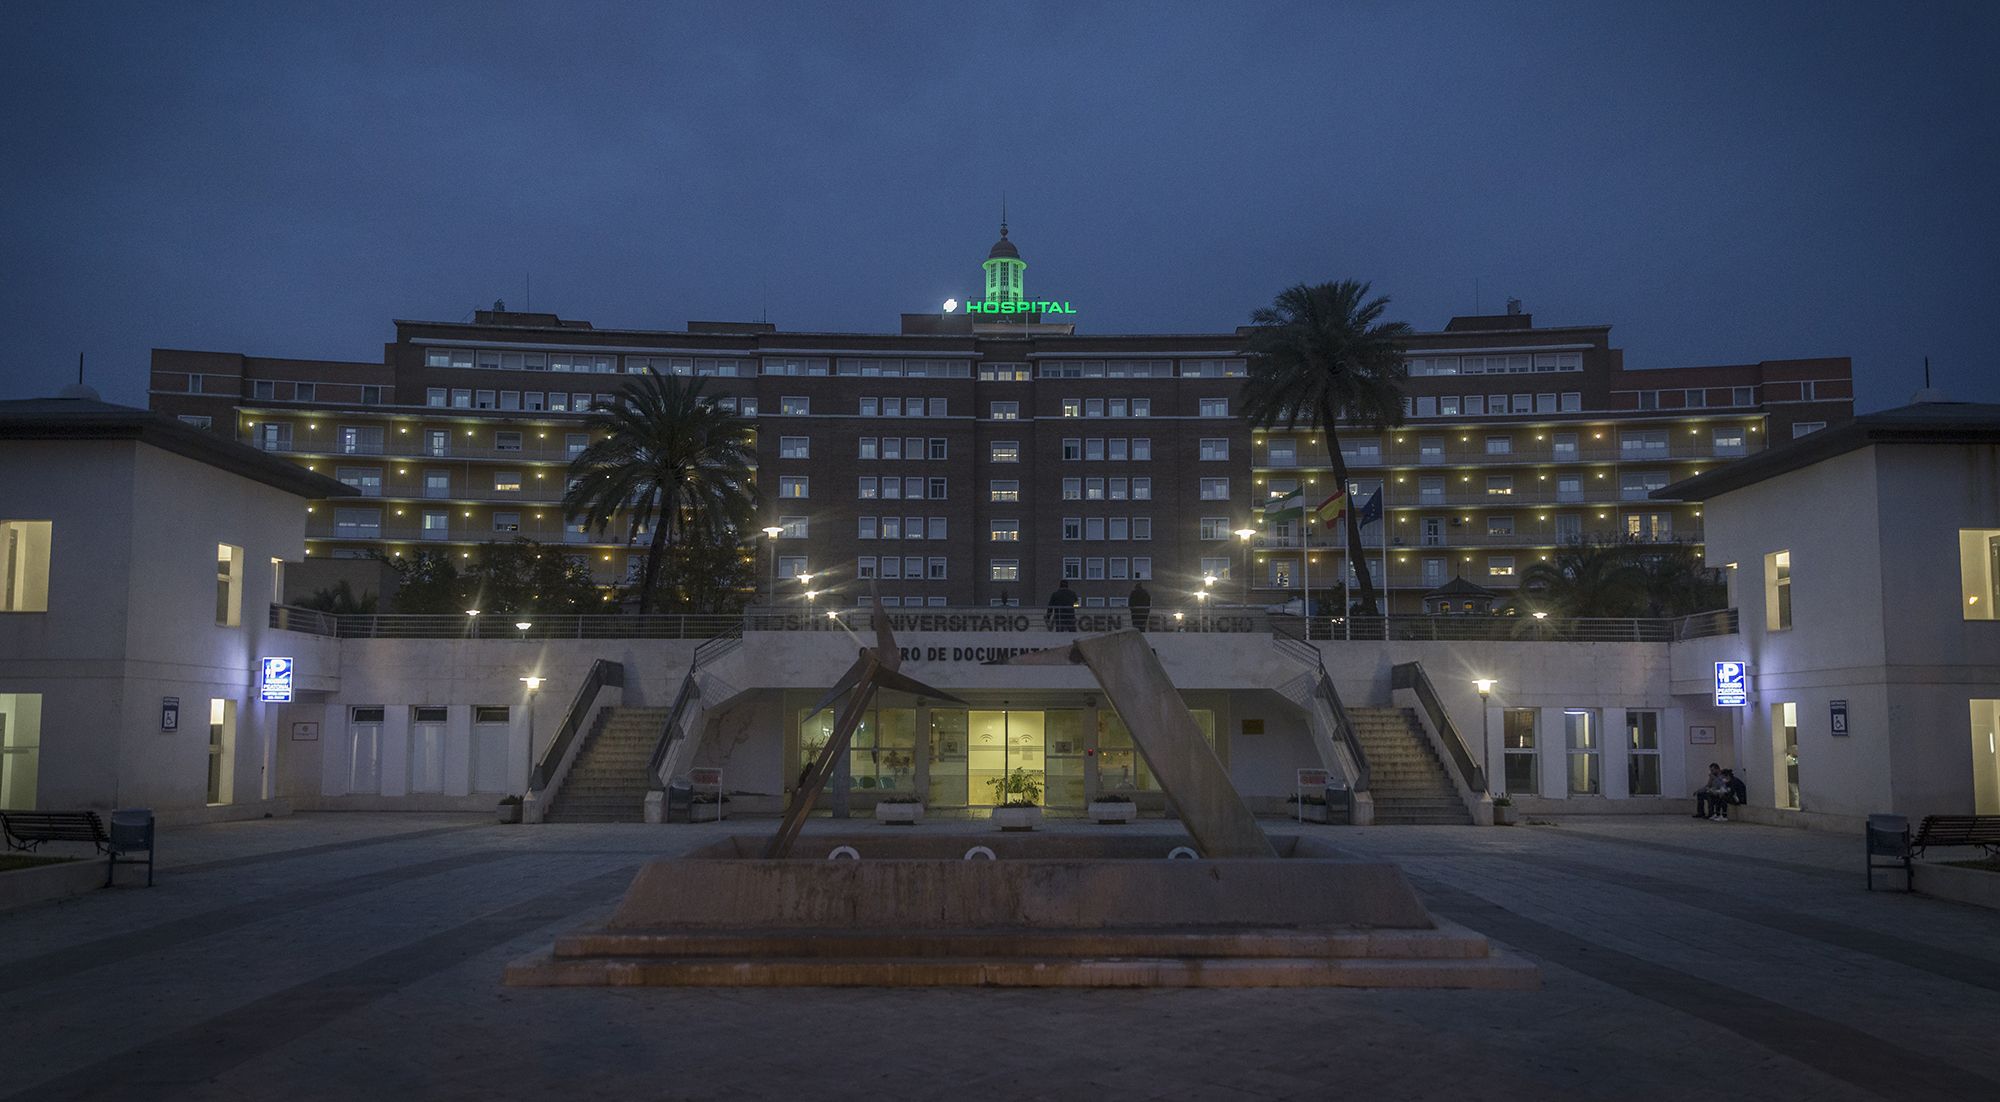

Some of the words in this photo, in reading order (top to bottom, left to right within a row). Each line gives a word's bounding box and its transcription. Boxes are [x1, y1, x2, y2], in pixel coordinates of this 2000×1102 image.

[965, 301, 1077, 314] HOSPITAL
[754, 615, 858, 632] HOSPIL
[871, 615, 1029, 632] NIVERSITARIO
[1044, 615, 1122, 632] VGEN
[859, 647, 921, 661] CRO
[927, 647, 946, 661] DE
